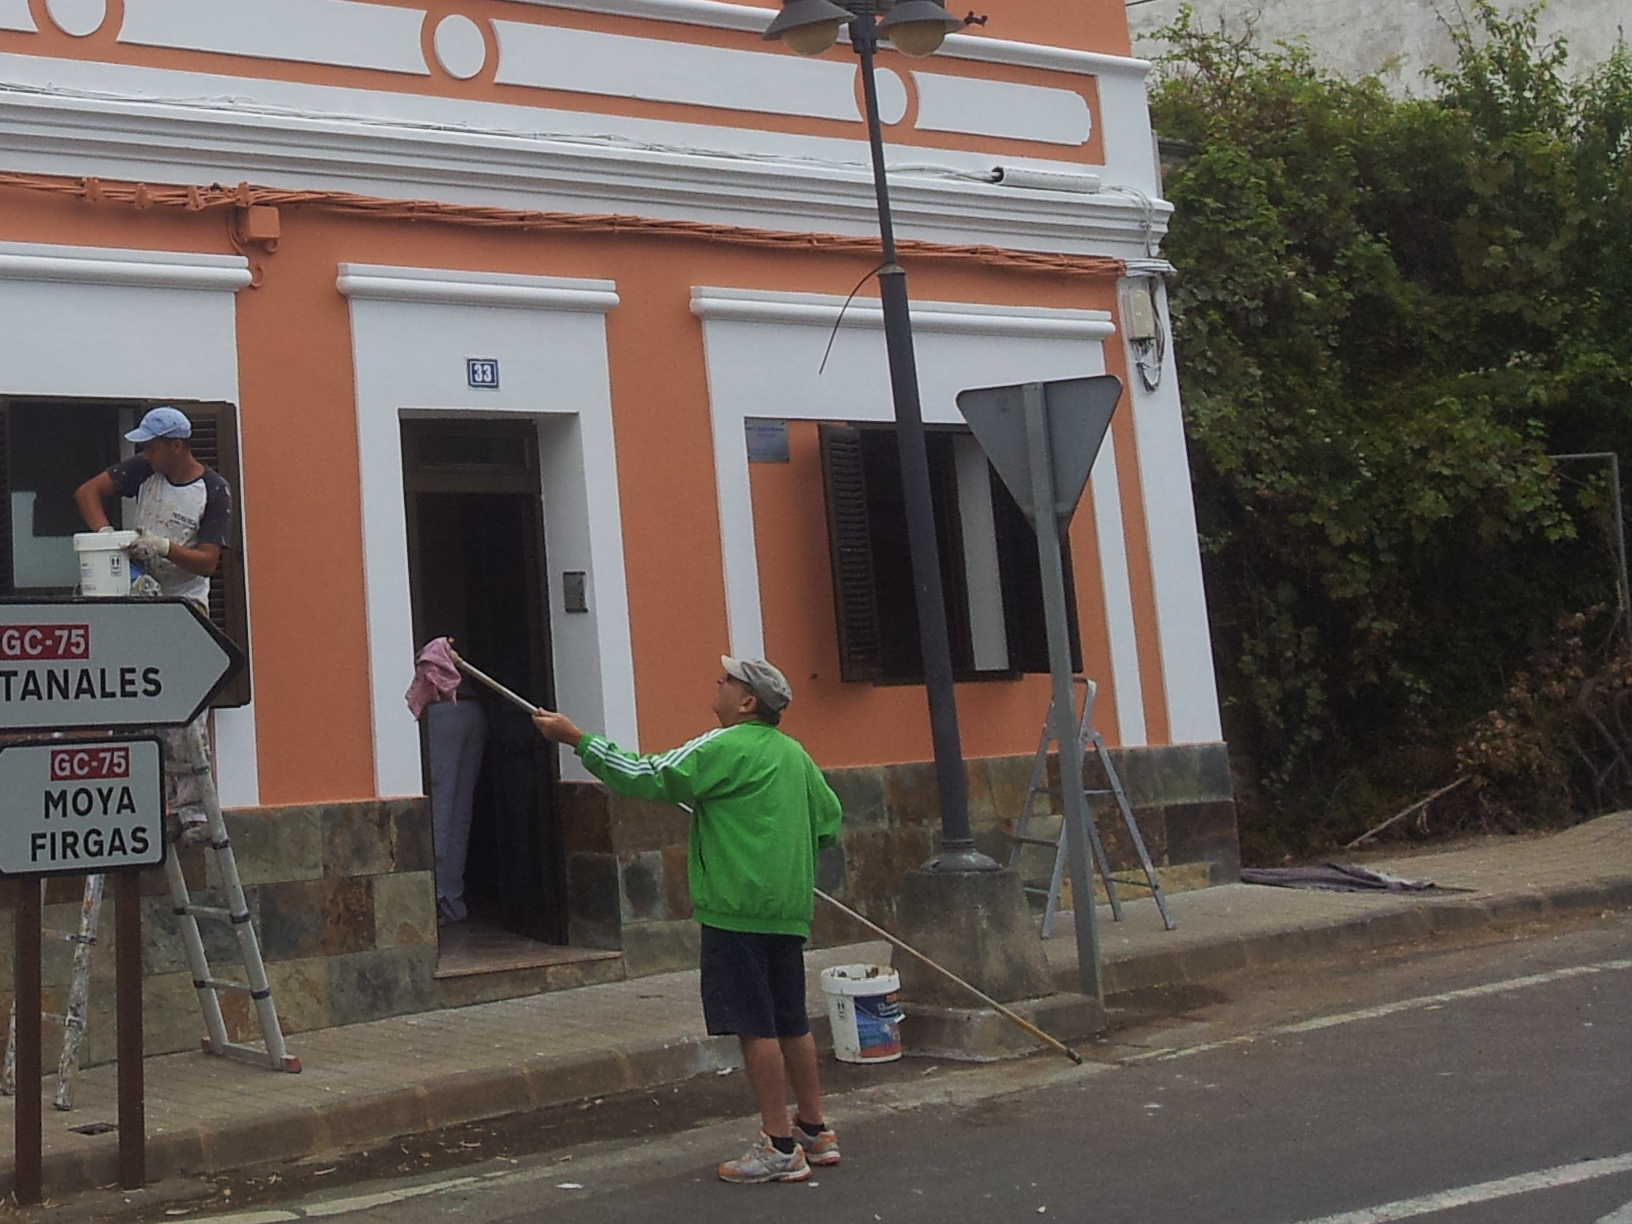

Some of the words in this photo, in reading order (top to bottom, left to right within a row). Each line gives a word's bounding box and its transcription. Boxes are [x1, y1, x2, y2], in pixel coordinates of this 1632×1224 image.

[473, 364, 492, 382] 33
[1, 629, 86, 655] GC-75
[53, 751, 128, 776] GC-75
[44, 786, 136, 819] MOYA
[30, 826, 150, 862] FIRGAS
